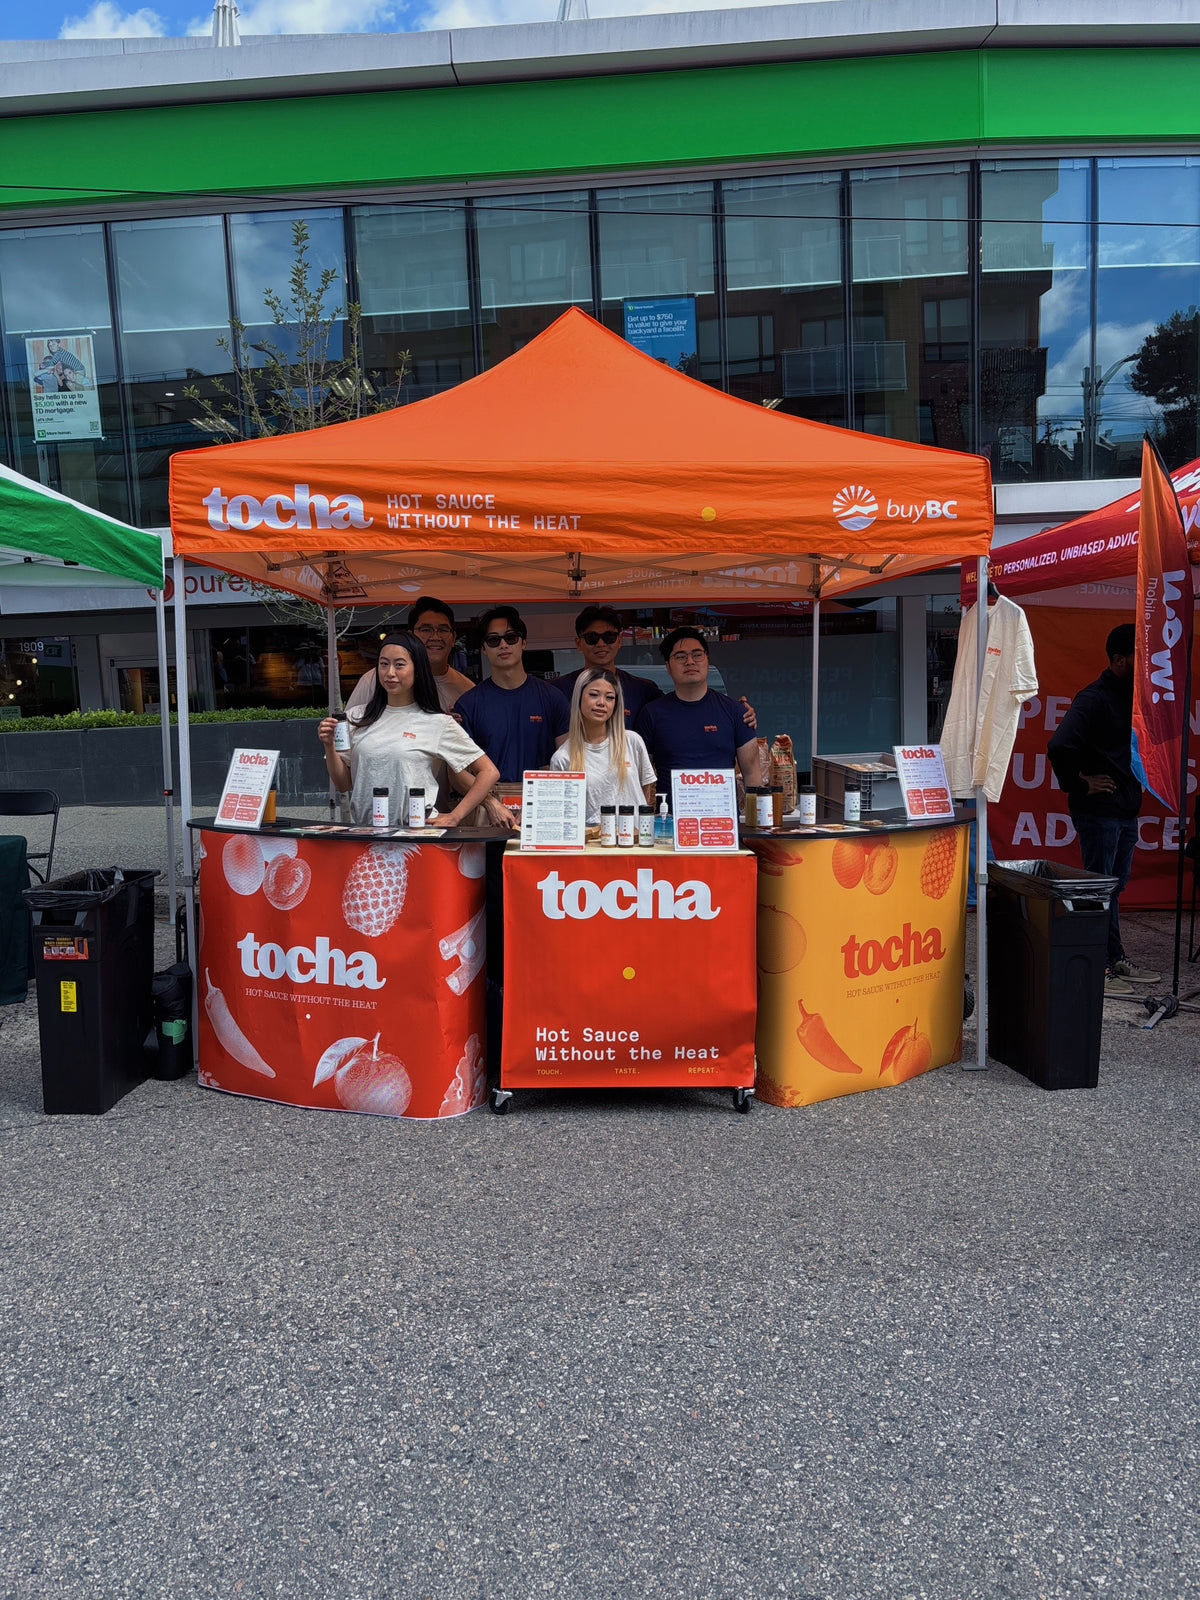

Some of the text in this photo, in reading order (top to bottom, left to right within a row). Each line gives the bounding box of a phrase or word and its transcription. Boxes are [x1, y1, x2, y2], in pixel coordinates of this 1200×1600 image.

[202, 484, 373, 531] tocha
[387, 494, 496, 509] HOT SAUCE
[886, 499, 958, 524] buyBC
[387, 513, 581, 530] WITHOUT THE HEAT
[966, 530, 1139, 584] WELE TO PERSONALIZED, UNBIASED ADVIC
[1145, 578, 1158, 620] mobile
[19, 641, 44, 652] 1909
[239, 753, 269, 766] tocha
[901, 747, 936, 759] tocha
[680, 772, 726, 784] tocha
[1012, 812, 1190, 850] ADCE
[537, 868, 721, 920] tocha
[236, 932, 386, 990] tocha
[840, 922, 946, 978] tocha
[846, 971, 941, 998] HOT SAUCE WITHOUT THE HEAT
[245, 988, 377, 1010] HOT SAUCE WITHOUT THE HEAT
[536, 1027, 640, 1042] Hot Sauce
[536, 1046, 719, 1062] Without the Heat
